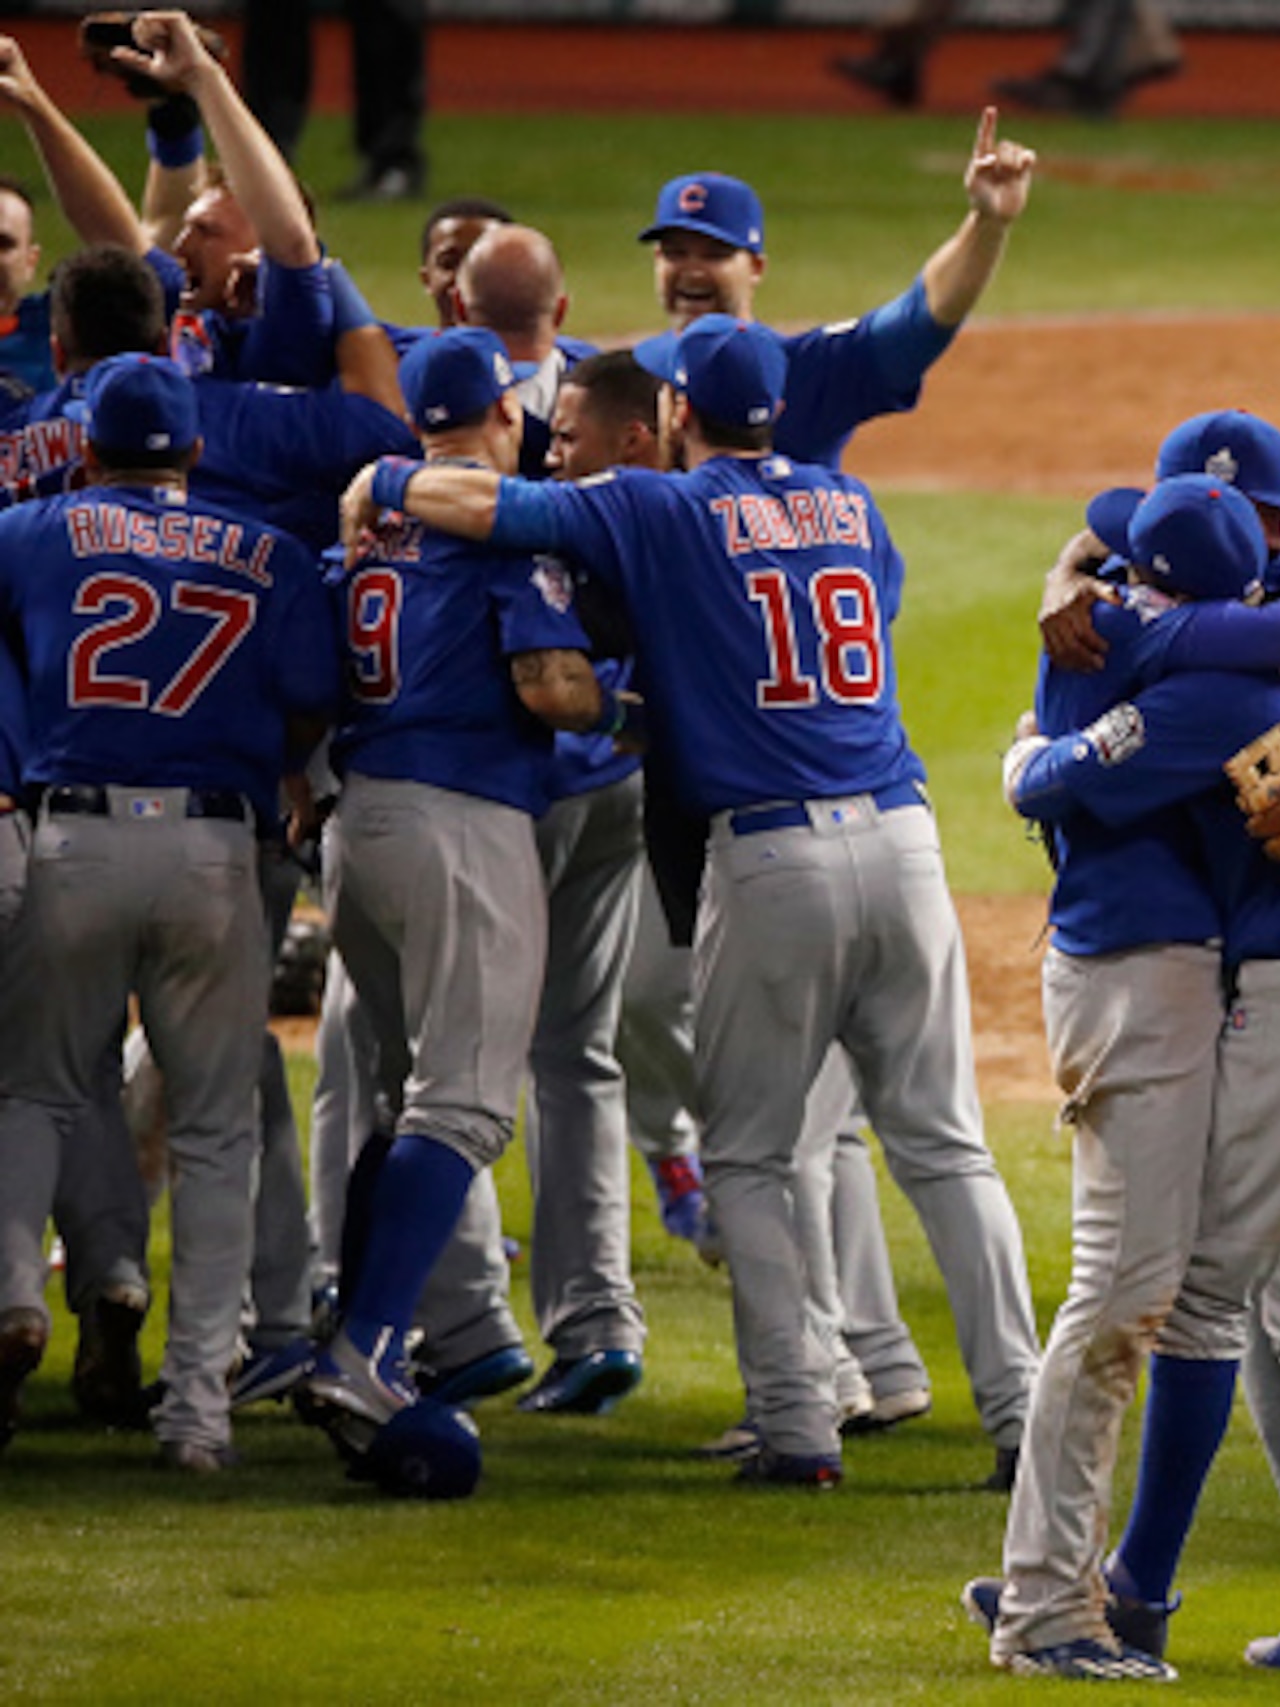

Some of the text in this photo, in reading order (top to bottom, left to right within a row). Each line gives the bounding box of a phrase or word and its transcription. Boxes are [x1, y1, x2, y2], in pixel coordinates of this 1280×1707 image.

[67, 502, 276, 588] RUSSELL
[68, 571, 257, 717] 27
[349, 567, 403, 705] 9
[746, 566, 884, 709] 18
